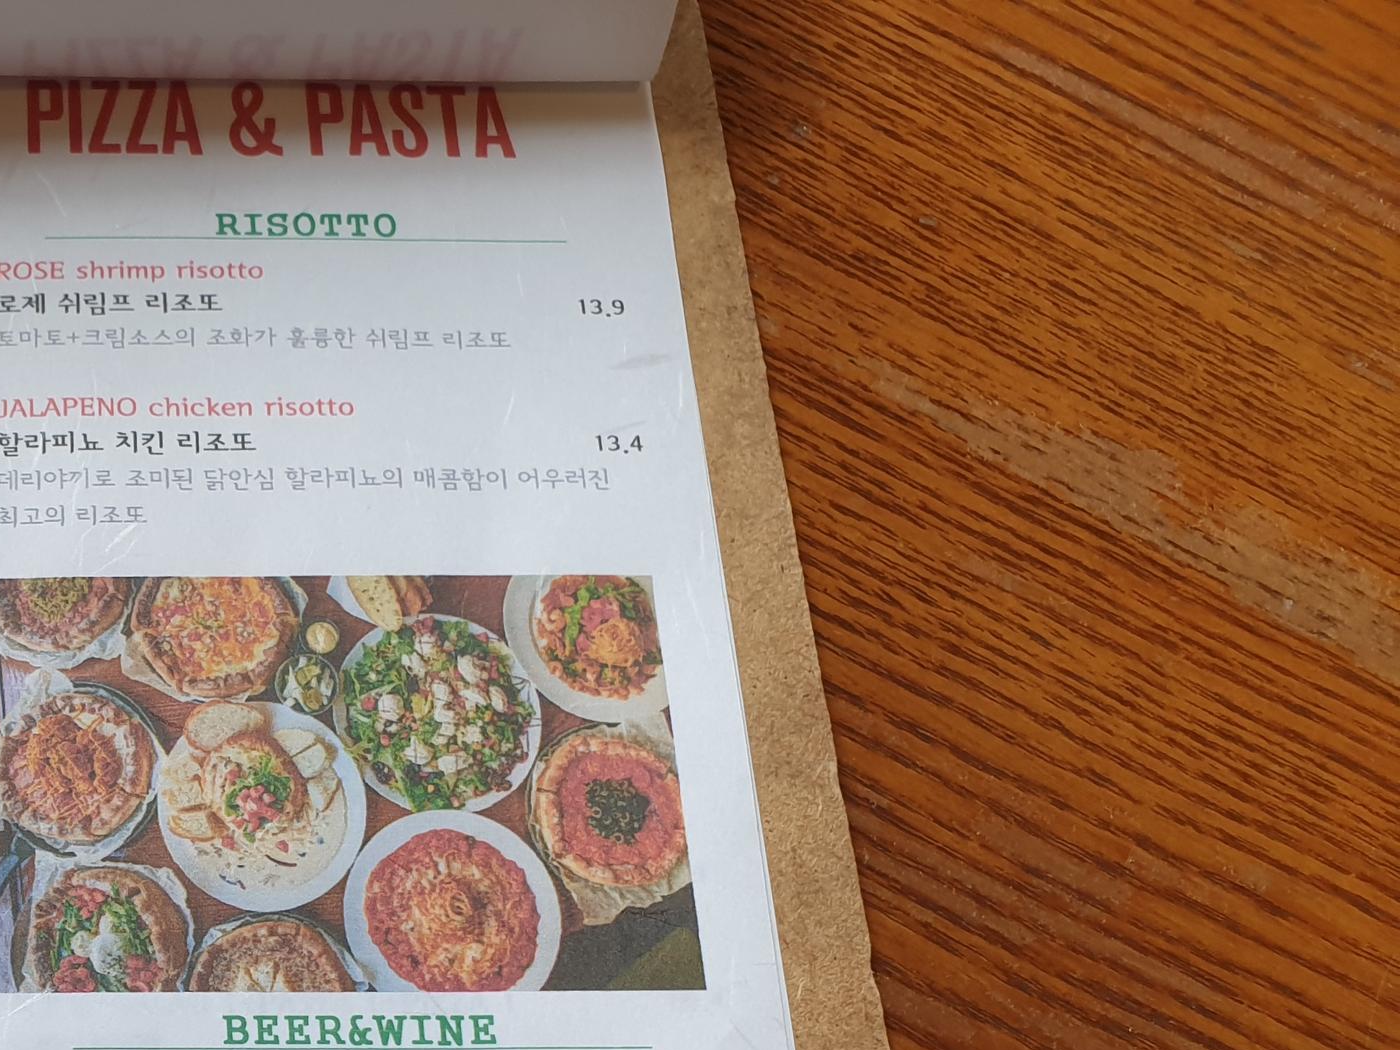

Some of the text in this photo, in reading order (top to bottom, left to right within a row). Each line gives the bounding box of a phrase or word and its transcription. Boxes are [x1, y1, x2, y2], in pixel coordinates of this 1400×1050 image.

[25, 80, 204, 155] PIZZA
[228, 81, 284, 158] &
[306, 82, 517, 159] PASTA
[215, 211, 397, 239] RISOTTO
[76, 260, 166, 284] shrimp
[176, 259, 264, 280] risotto
[58, 291, 135, 316] 쉬림프
[145, 291, 223, 314] 리조또
[579, 298, 625, 318] 13.9
[148, 396, 253, 417] chicken
[264, 396, 355, 417] risotto
[115, 430, 164, 456] 치킨
[176, 430, 257, 455] 리조또
[595, 434, 644, 455] 13.4
[124, 467, 193, 491] 조미된
[203, 467, 275, 492] 닭안심
[284, 466, 403, 491] 할라피뇨의
[412, 466, 508, 492] 매콤함이
[517, 467, 610, 491] 어우러진
[75, 504, 148, 526] 리조또
[221, 1014, 498, 1047] BEER&WINE
